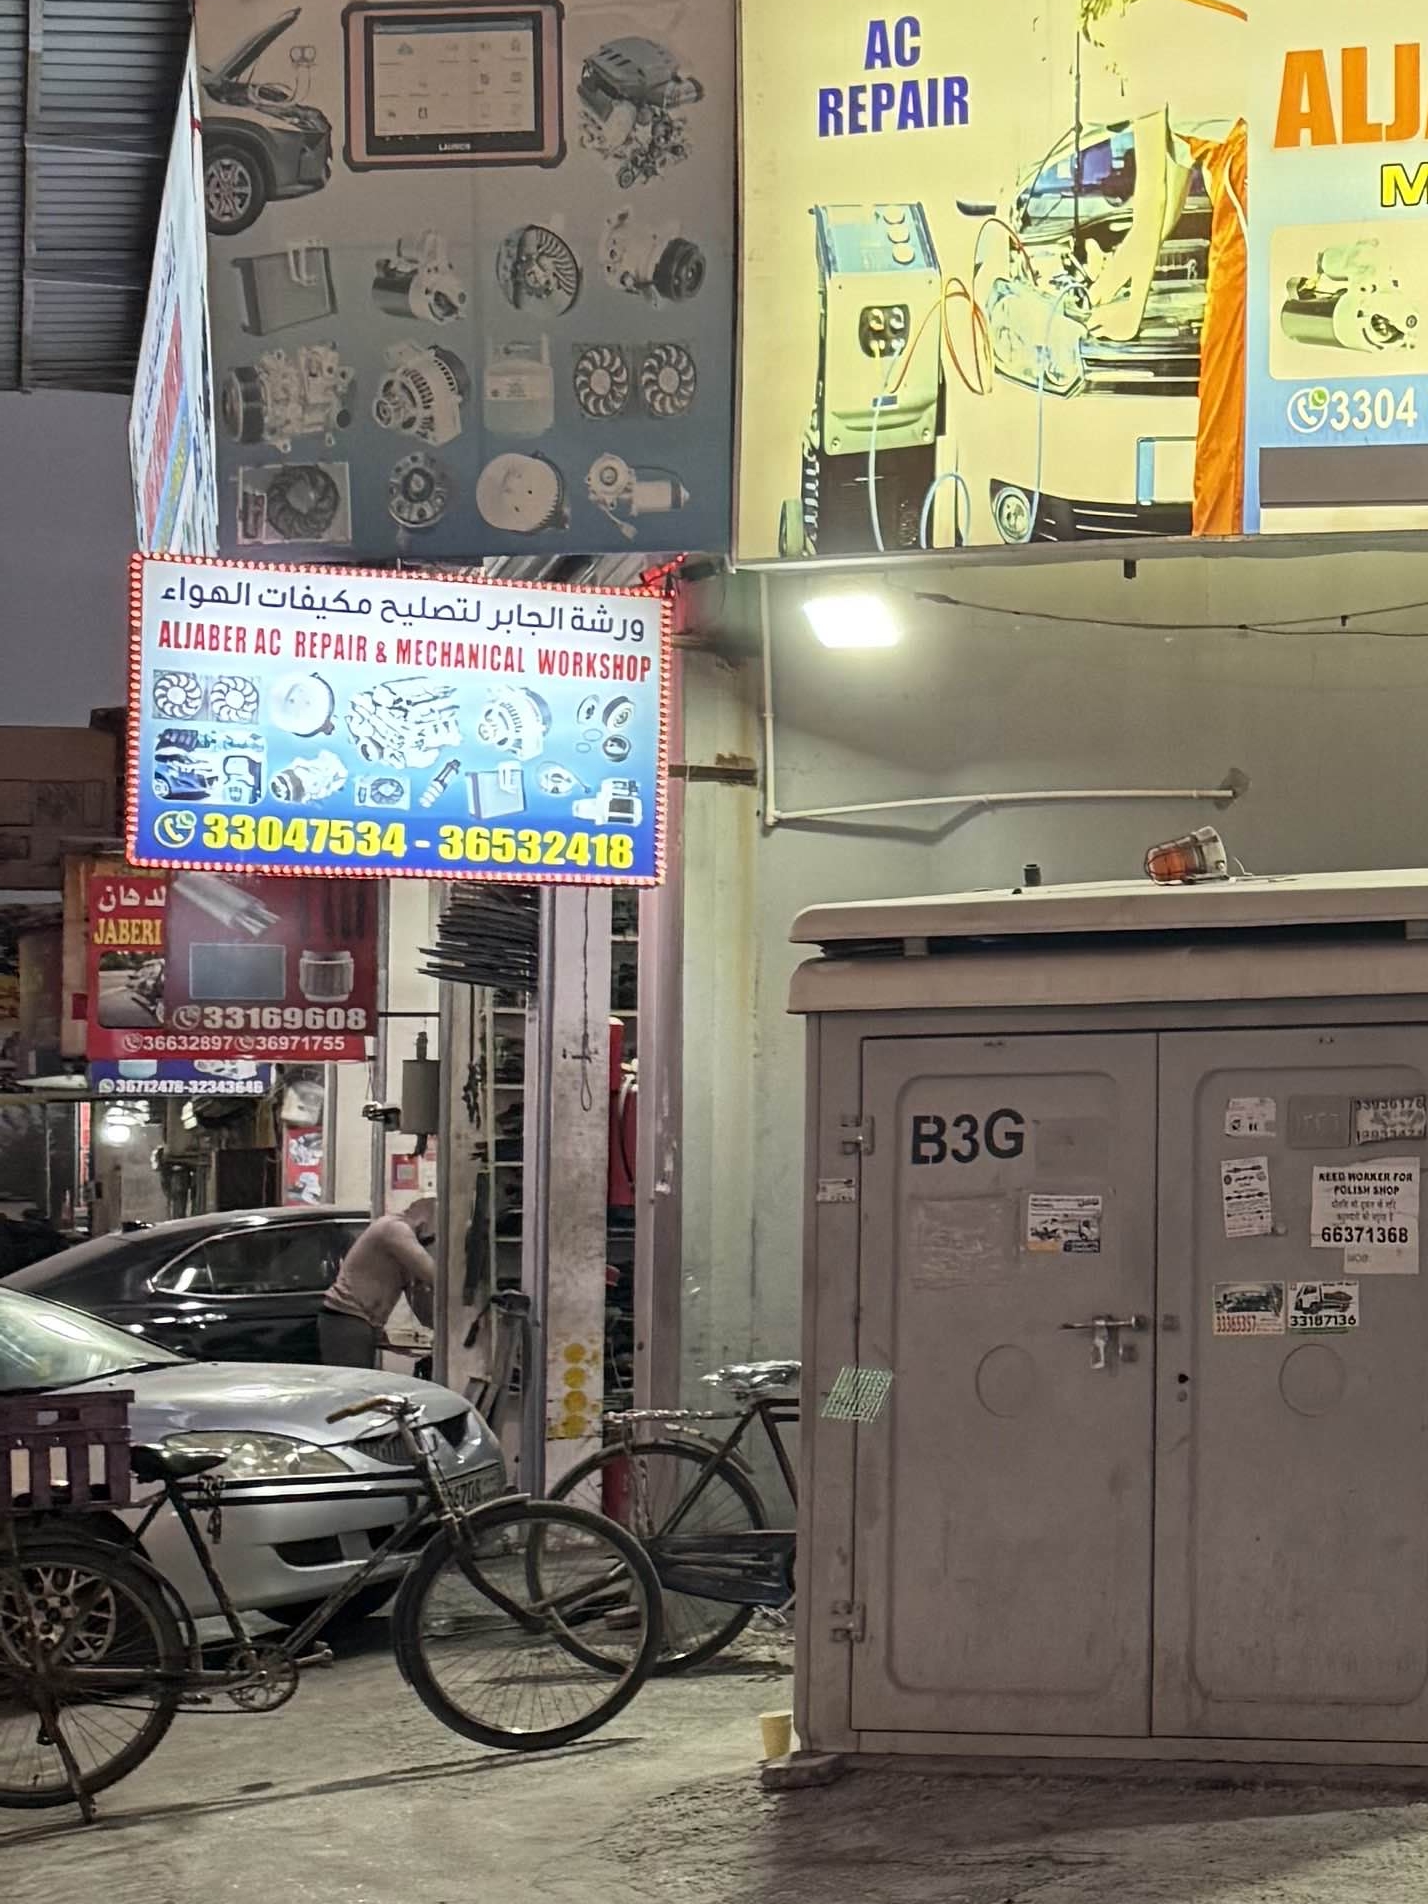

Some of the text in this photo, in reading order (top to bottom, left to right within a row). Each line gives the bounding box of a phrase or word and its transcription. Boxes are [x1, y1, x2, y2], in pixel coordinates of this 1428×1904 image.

[864, 15, 921, 70] AC
[818, 75, 970, 137] REPAIR
[1329, 384, 1417, 432] 3304
[161, 576, 646, 644] ورشة الجابر لتصليح مكيفات الهواء
[158, 620, 652, 684] ALJABER AC REPAIR & MECHANICAL WORKSHOP
[203, 812, 407, 858] 33047534
[438, 824, 635, 869] 36532418
[203, 1006, 368, 1030] 33169608
[143, 1035, 345, 1051] 36632897 36971755
[911, 1108, 1025, 1165] B3G
[1334, 1185, 1400, 1196] POLISH SHOP
[1348, 1172, 1390, 1182] WORKER
[1393, 1172, 1413, 1182] FOR
[1321, 1226, 1409, 1243] 66371368
[1290, 1314, 1357, 1327] 33187136
